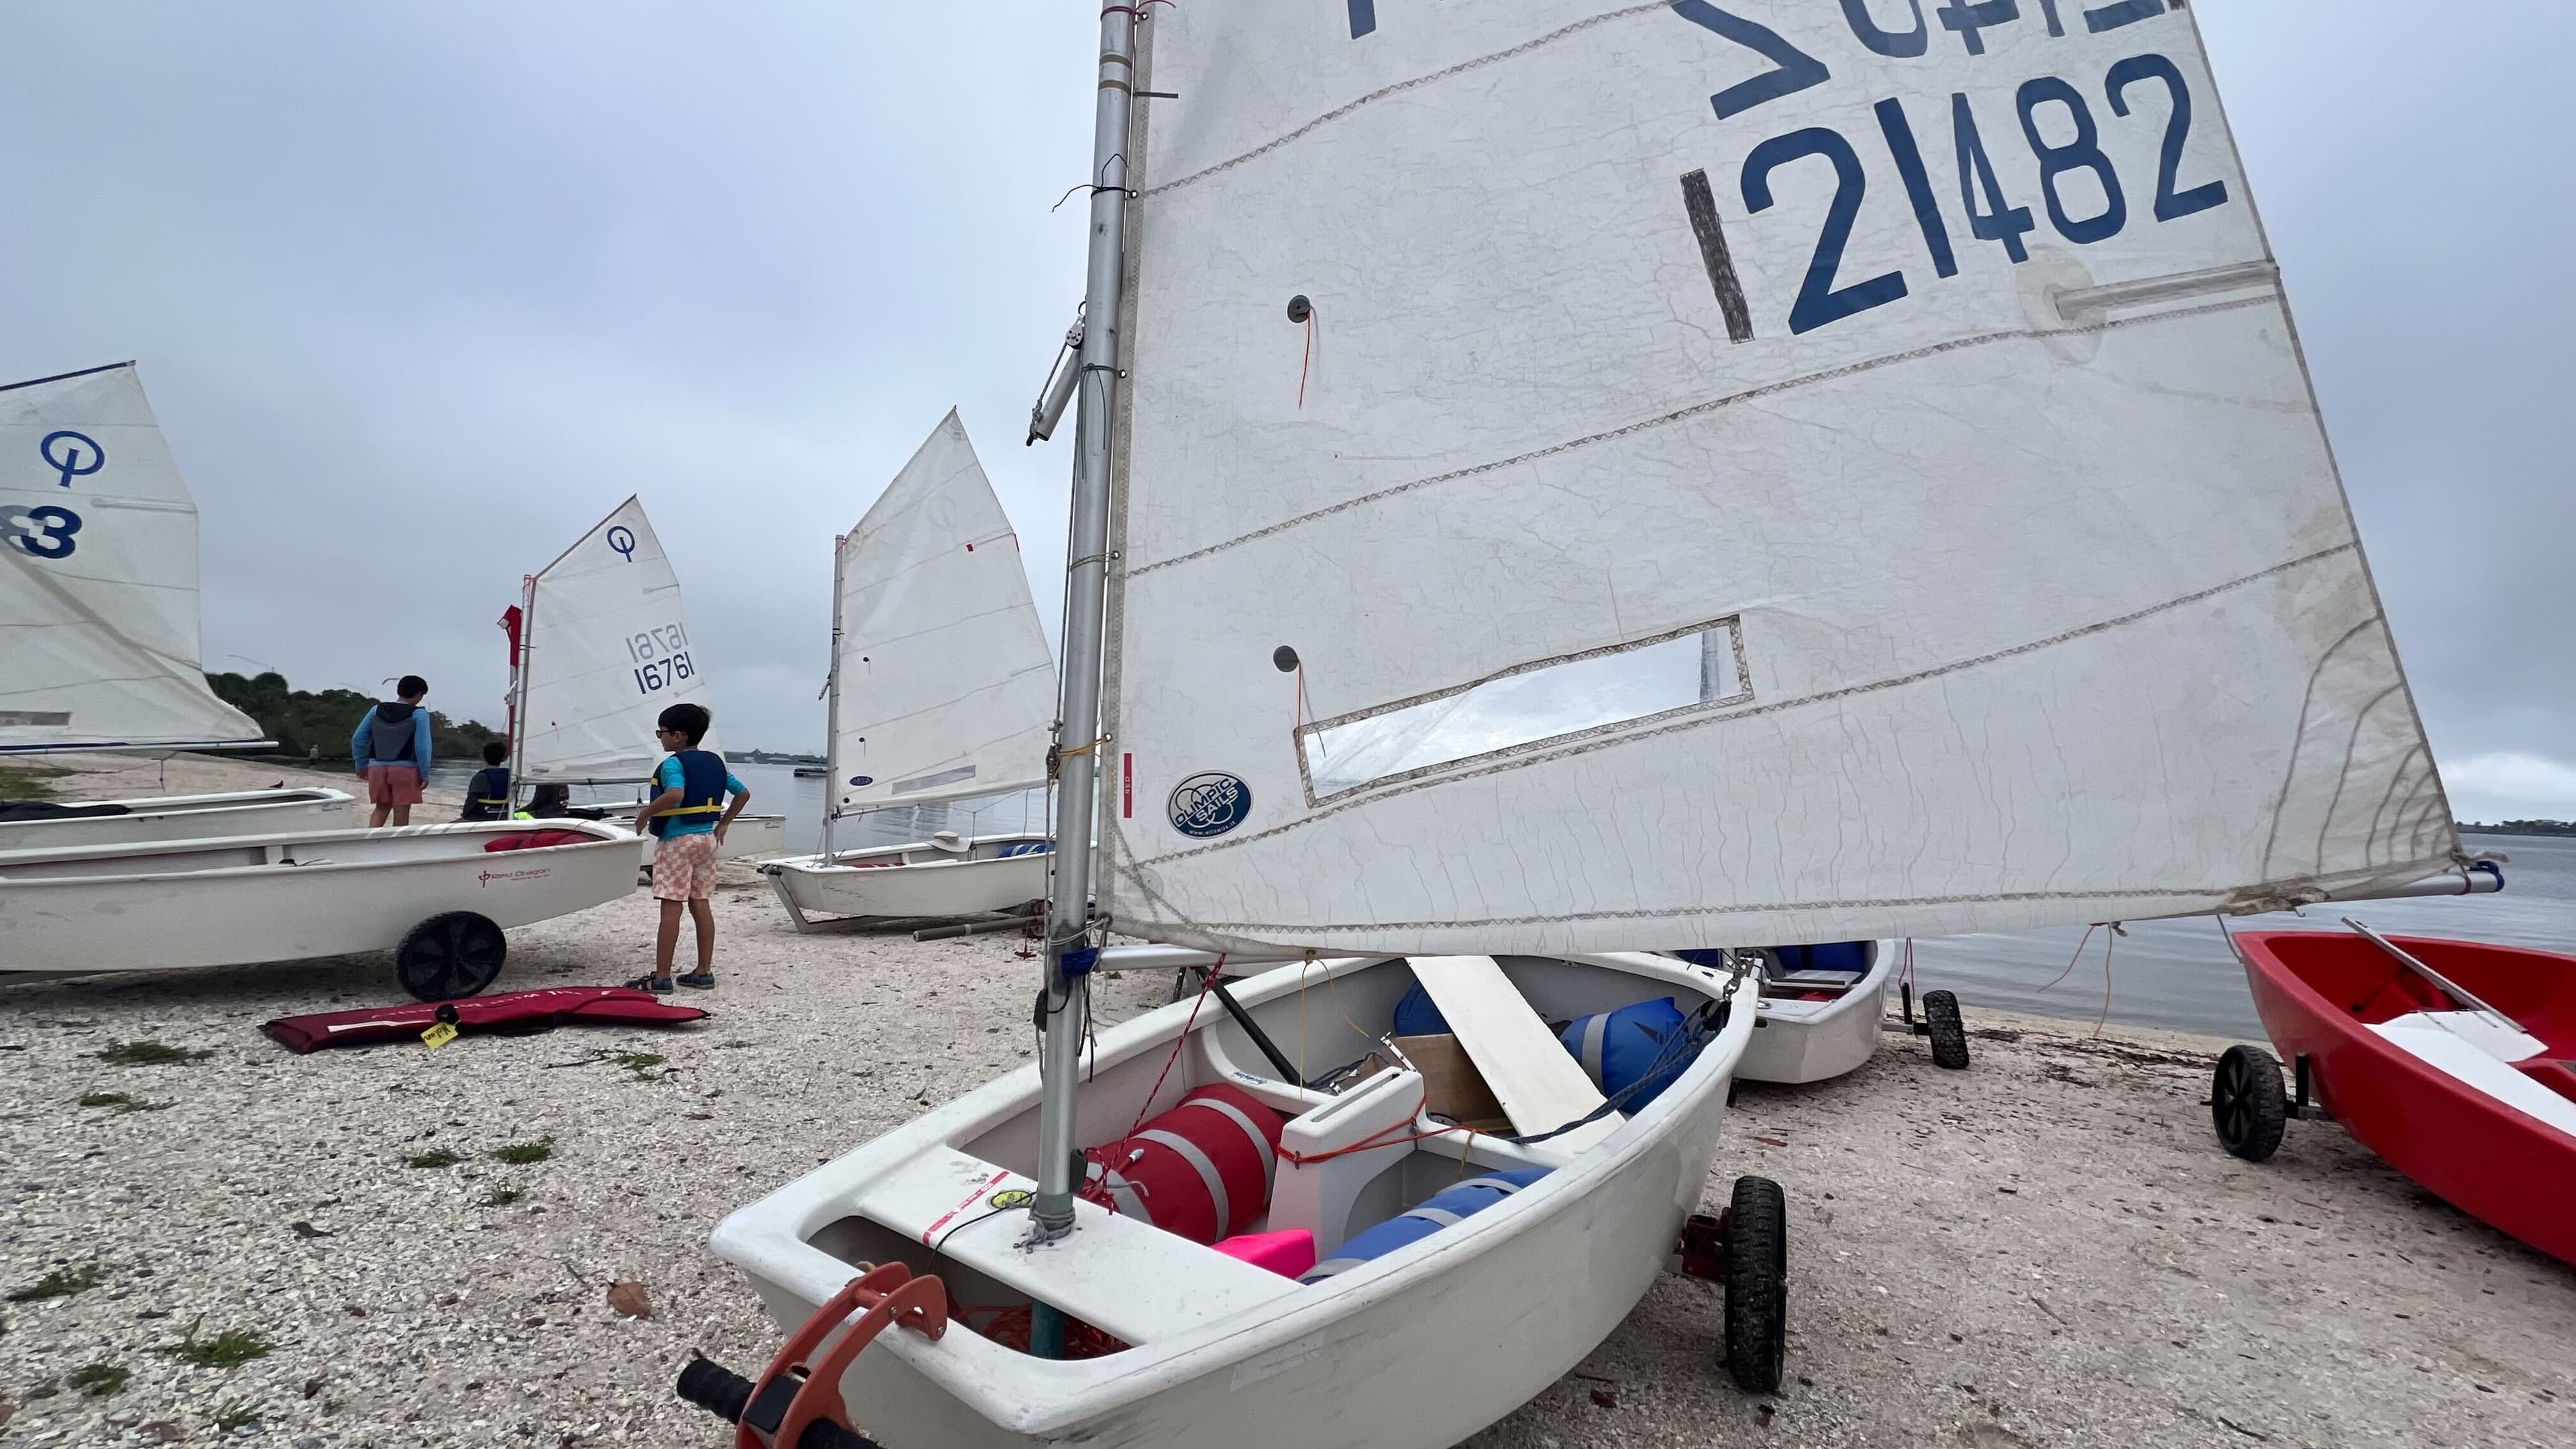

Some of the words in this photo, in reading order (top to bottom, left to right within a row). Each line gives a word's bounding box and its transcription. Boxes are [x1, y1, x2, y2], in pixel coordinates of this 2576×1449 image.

[1680, 54, 2228, 343] 121482
[634, 651, 695, 694] 16761
[1175, 778, 1232, 825] OLIMPIC
[1195, 786, 1238, 822] SAILS
[515, 868, 551, 877] Dragon
